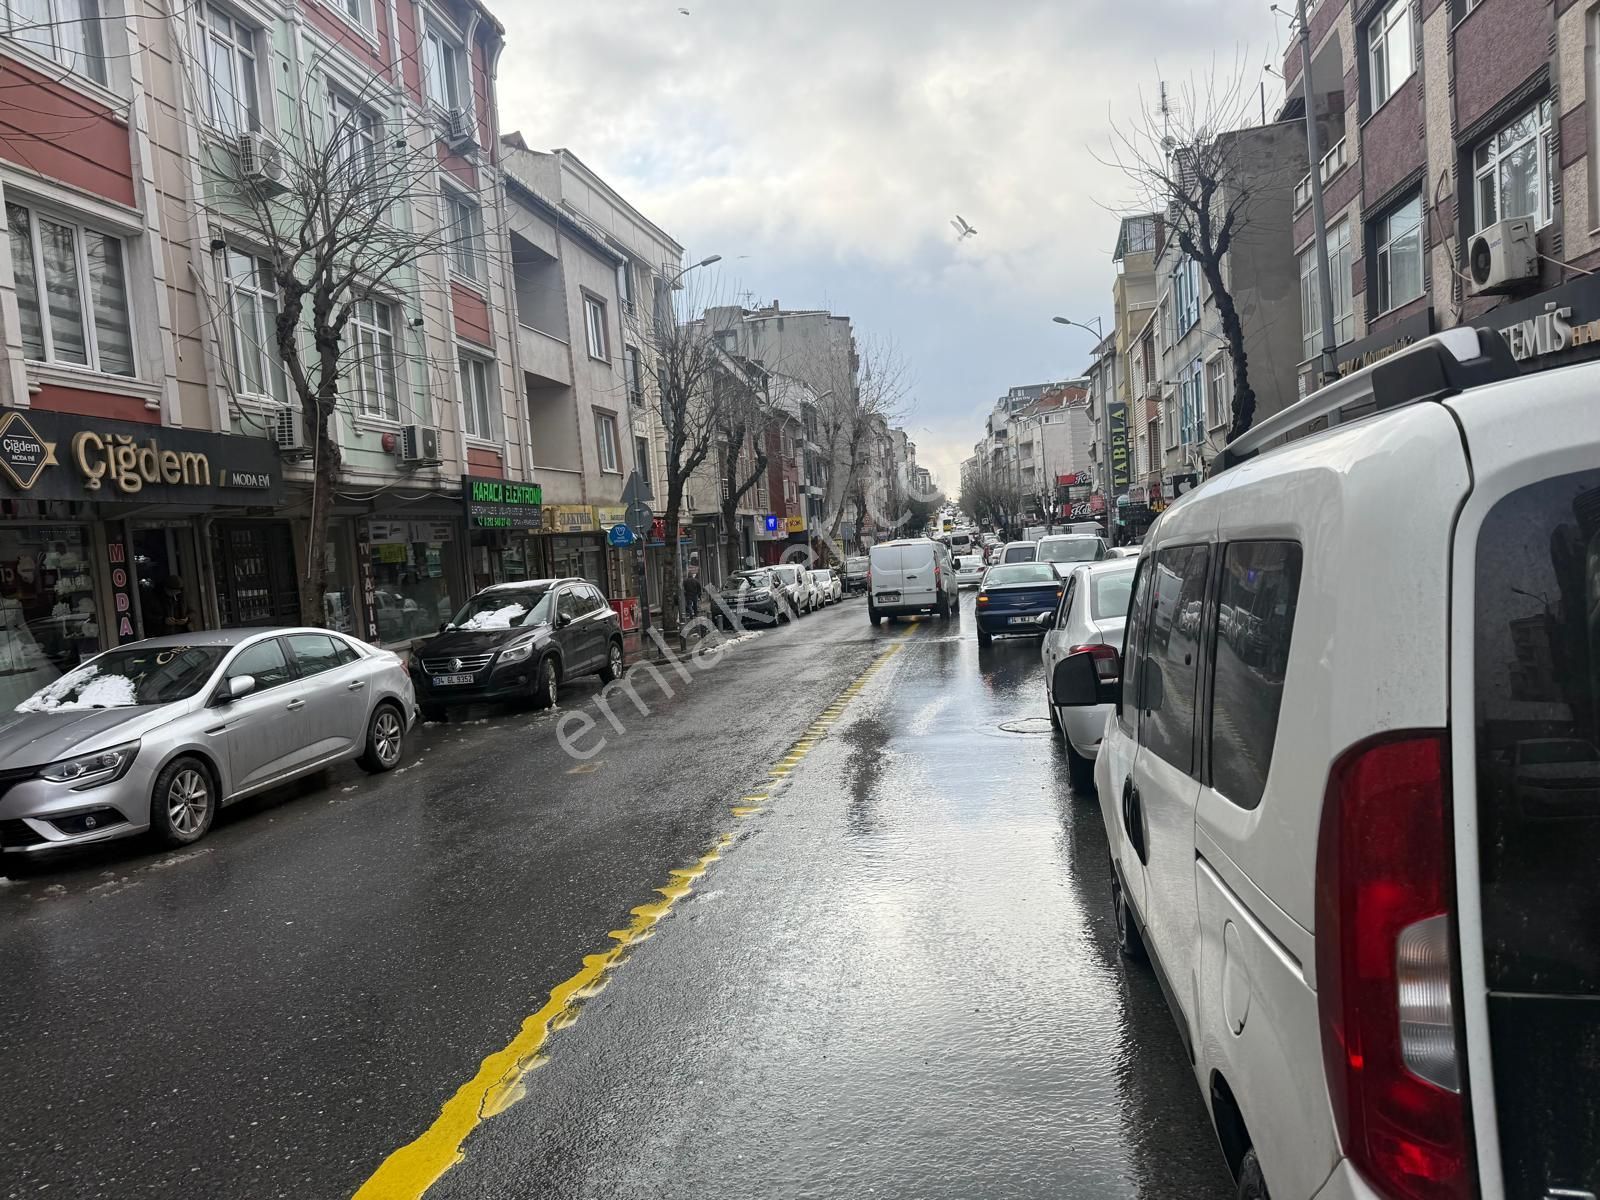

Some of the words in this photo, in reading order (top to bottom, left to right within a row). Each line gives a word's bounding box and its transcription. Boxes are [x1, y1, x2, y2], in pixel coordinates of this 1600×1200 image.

[3, 439, 40, 453] Çiğdem
[72, 431, 210, 492] Çiğdem
[1111, 408, 1128, 488] TABELA
[232, 473, 258, 486] MODA
[472, 481, 503, 502] KARACA
[108, 543, 134, 636] MODA
